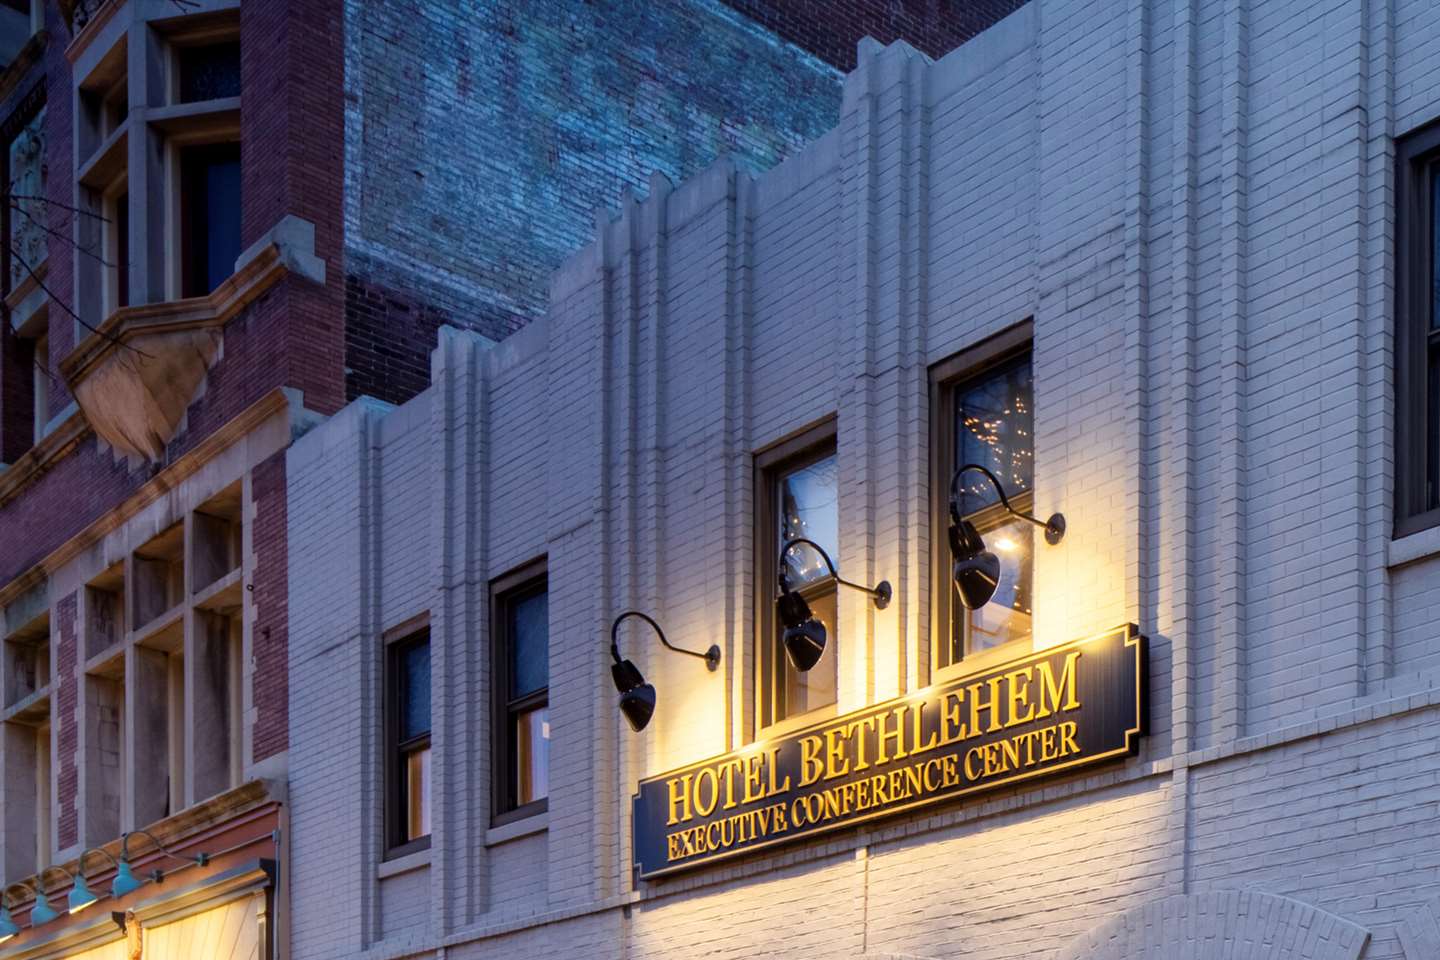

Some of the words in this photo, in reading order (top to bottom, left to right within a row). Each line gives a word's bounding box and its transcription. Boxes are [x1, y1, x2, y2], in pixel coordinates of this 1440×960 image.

[666, 746, 791, 826] HOTEL
[797, 651, 1082, 788] BETHLEHEM
[667, 803, 788, 862] EXECUTIVE
[791, 756, 960, 828] CONFERENCE
[964, 720, 1081, 781] CENTER
